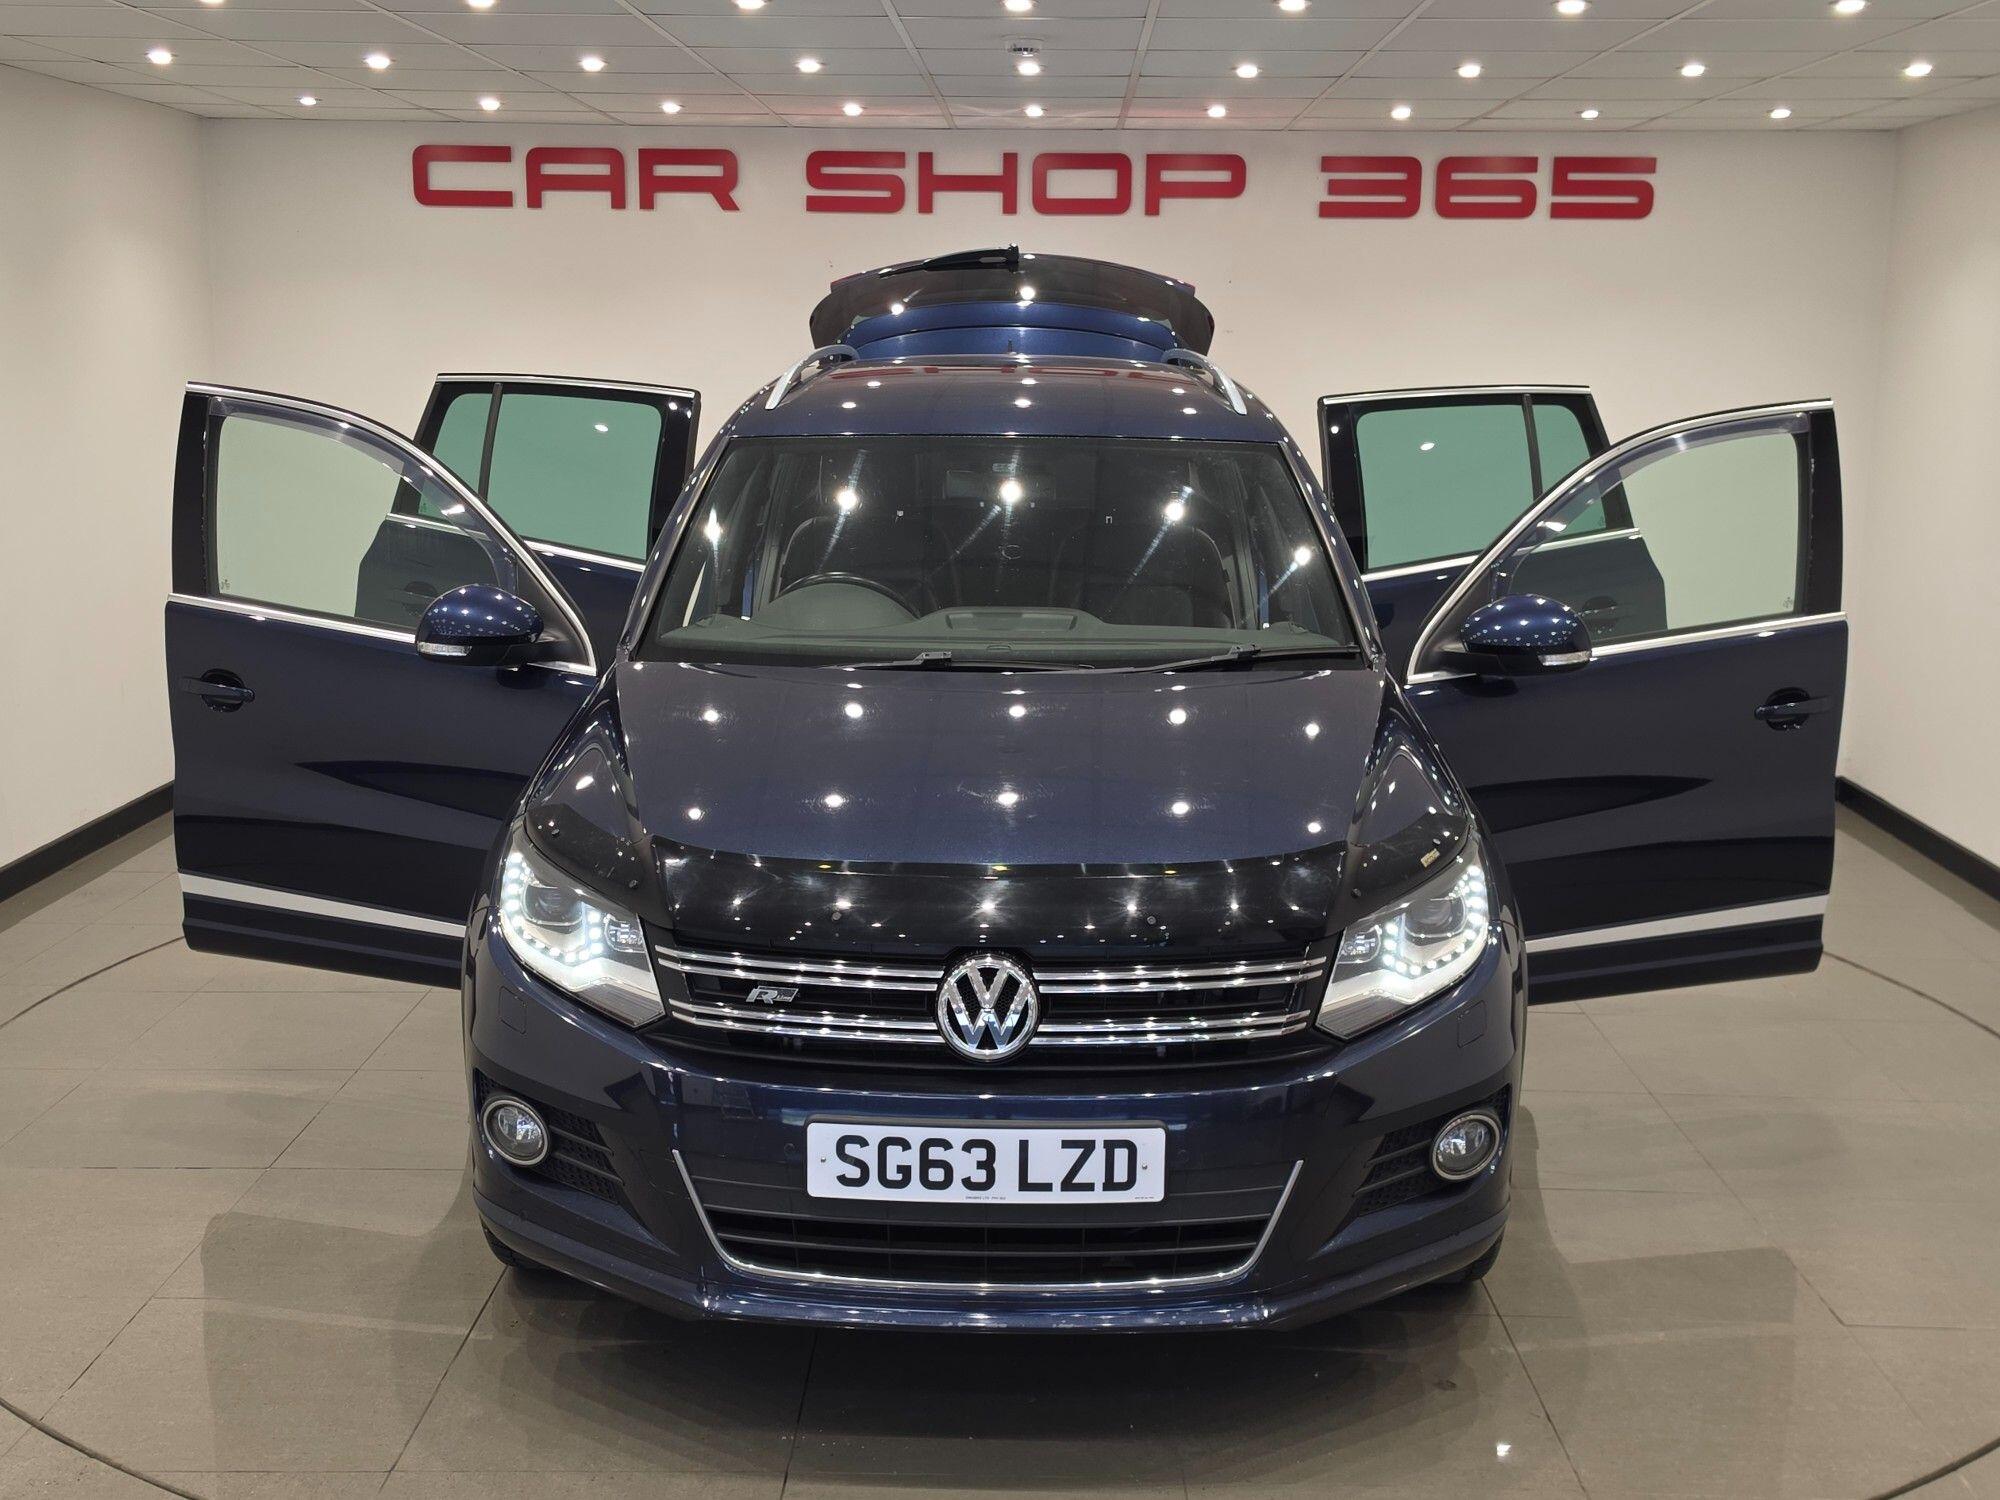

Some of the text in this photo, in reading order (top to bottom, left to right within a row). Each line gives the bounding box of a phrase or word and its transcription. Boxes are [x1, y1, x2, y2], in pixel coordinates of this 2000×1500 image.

[412, 144, 1657, 219] CAR SHOP 365
[835, 1134, 1138, 1192] SG63 LZD
